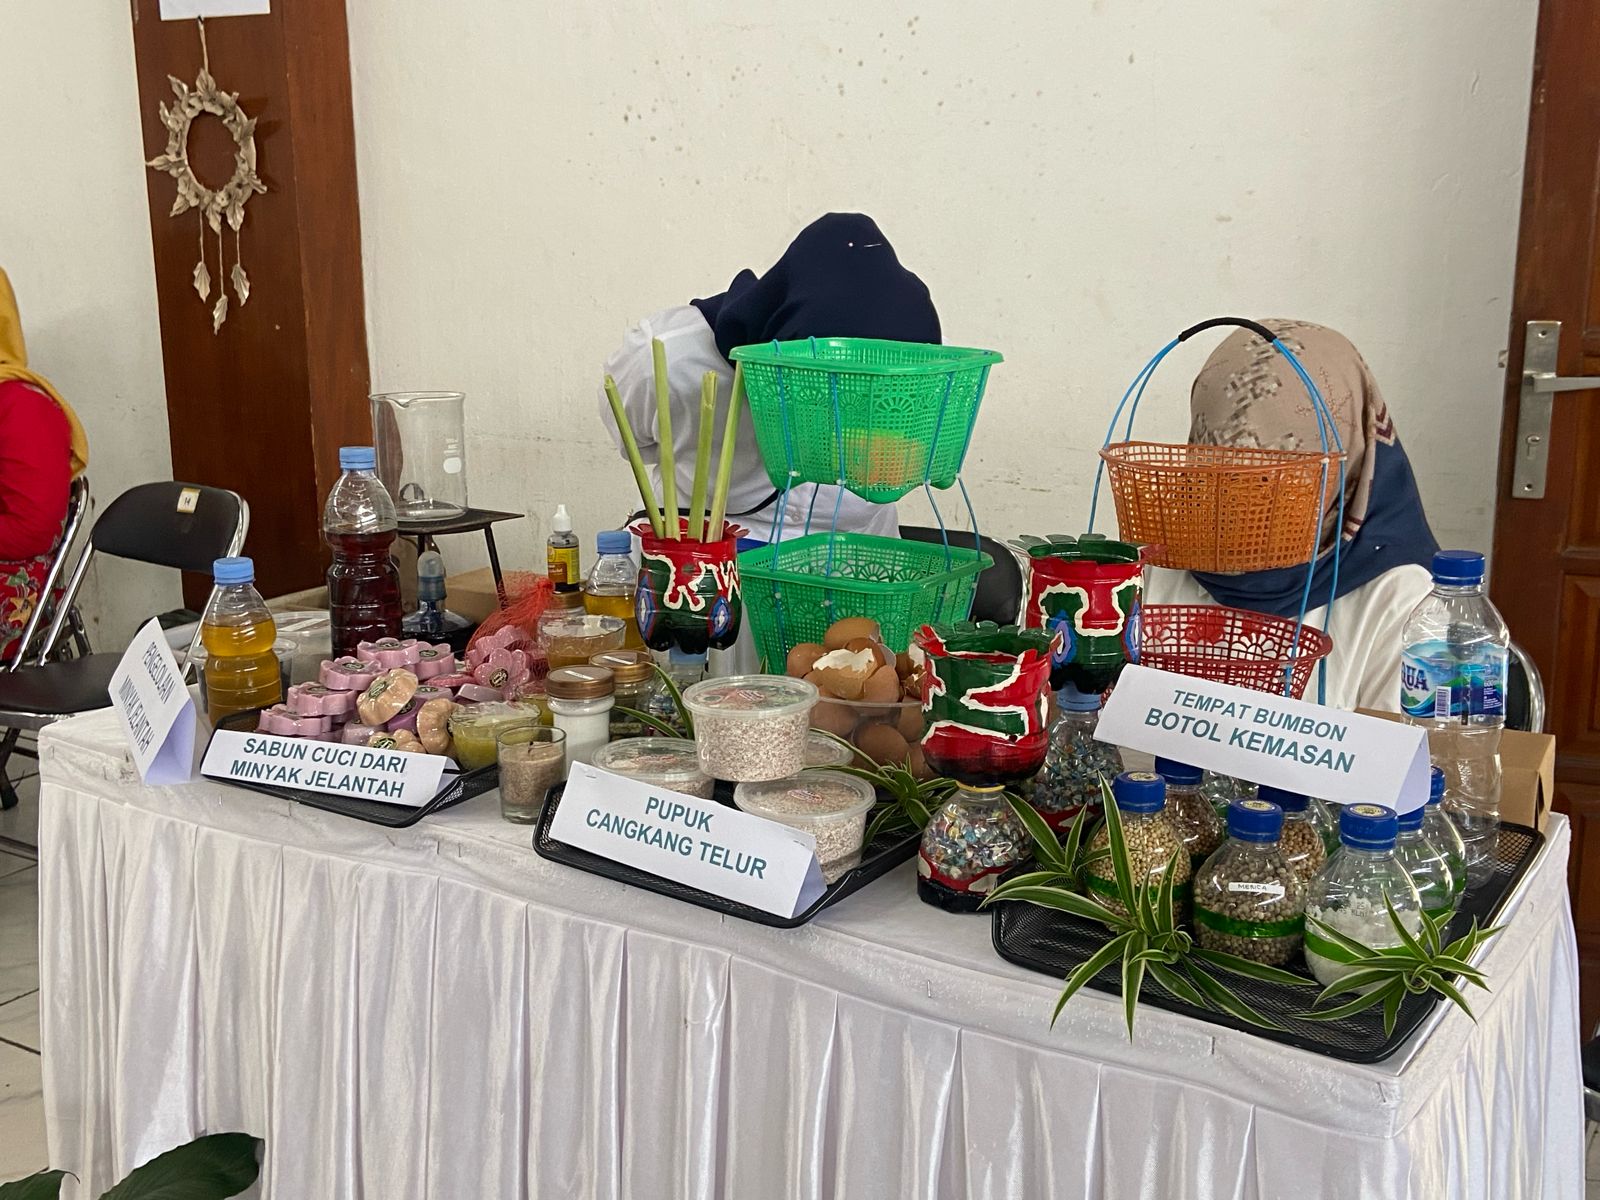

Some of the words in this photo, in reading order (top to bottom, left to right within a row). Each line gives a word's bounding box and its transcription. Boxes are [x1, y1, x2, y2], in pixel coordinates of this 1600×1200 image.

[127, 702, 155, 755] JELANTAH
[1144, 707, 1222, 743] BOTOL
[1228, 726, 1356, 774] KEMASAN
[1172, 689, 1252, 720] TEMPAT
[1252, 706, 1348, 742] BUMBON
[230, 759, 304, 784] MINYAK
[304, 769, 405, 799] JELANTAH
[243, 737, 308, 760] SABUN
[311, 746, 357, 767] CUCI
[360, 751, 408, 774] DARI
[644, 796, 715, 833] PUPUK
[585, 808, 694, 857] CANGKANG
[699, 840, 768, 880] TELUR
